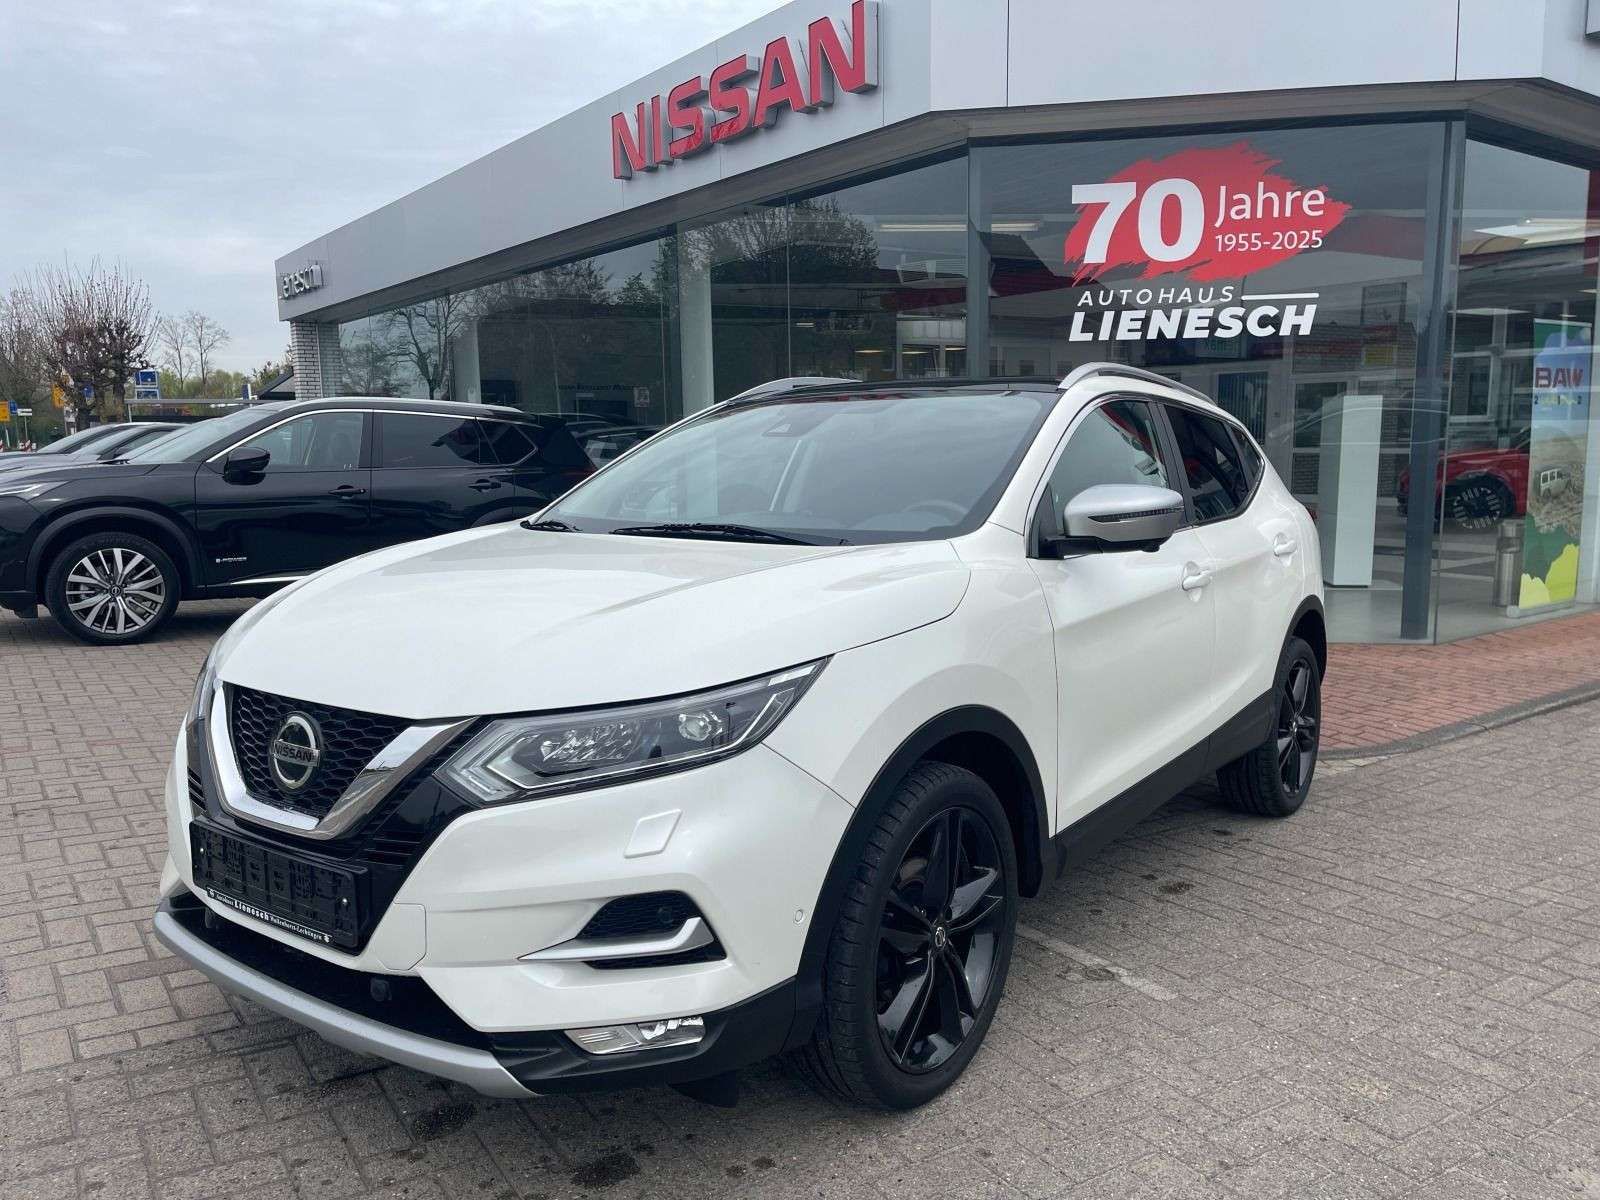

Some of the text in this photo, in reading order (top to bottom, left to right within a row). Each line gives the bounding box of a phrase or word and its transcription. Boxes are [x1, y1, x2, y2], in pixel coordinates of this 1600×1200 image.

[611, 0, 872, 180] NISSAN
[1214, 181, 1325, 228] Jahre
[1072, 178, 1205, 263] 70
[1215, 230, 1324, 252] 1955-2025
[1077, 286, 1235, 306] AUTOHAUS
[1068, 304, 1318, 342] LIENESCH
[1535, 367, 1584, 389] BAW
[274, 741, 313, 763] NISSAN
[234, 899, 269, 921] Lienesch
